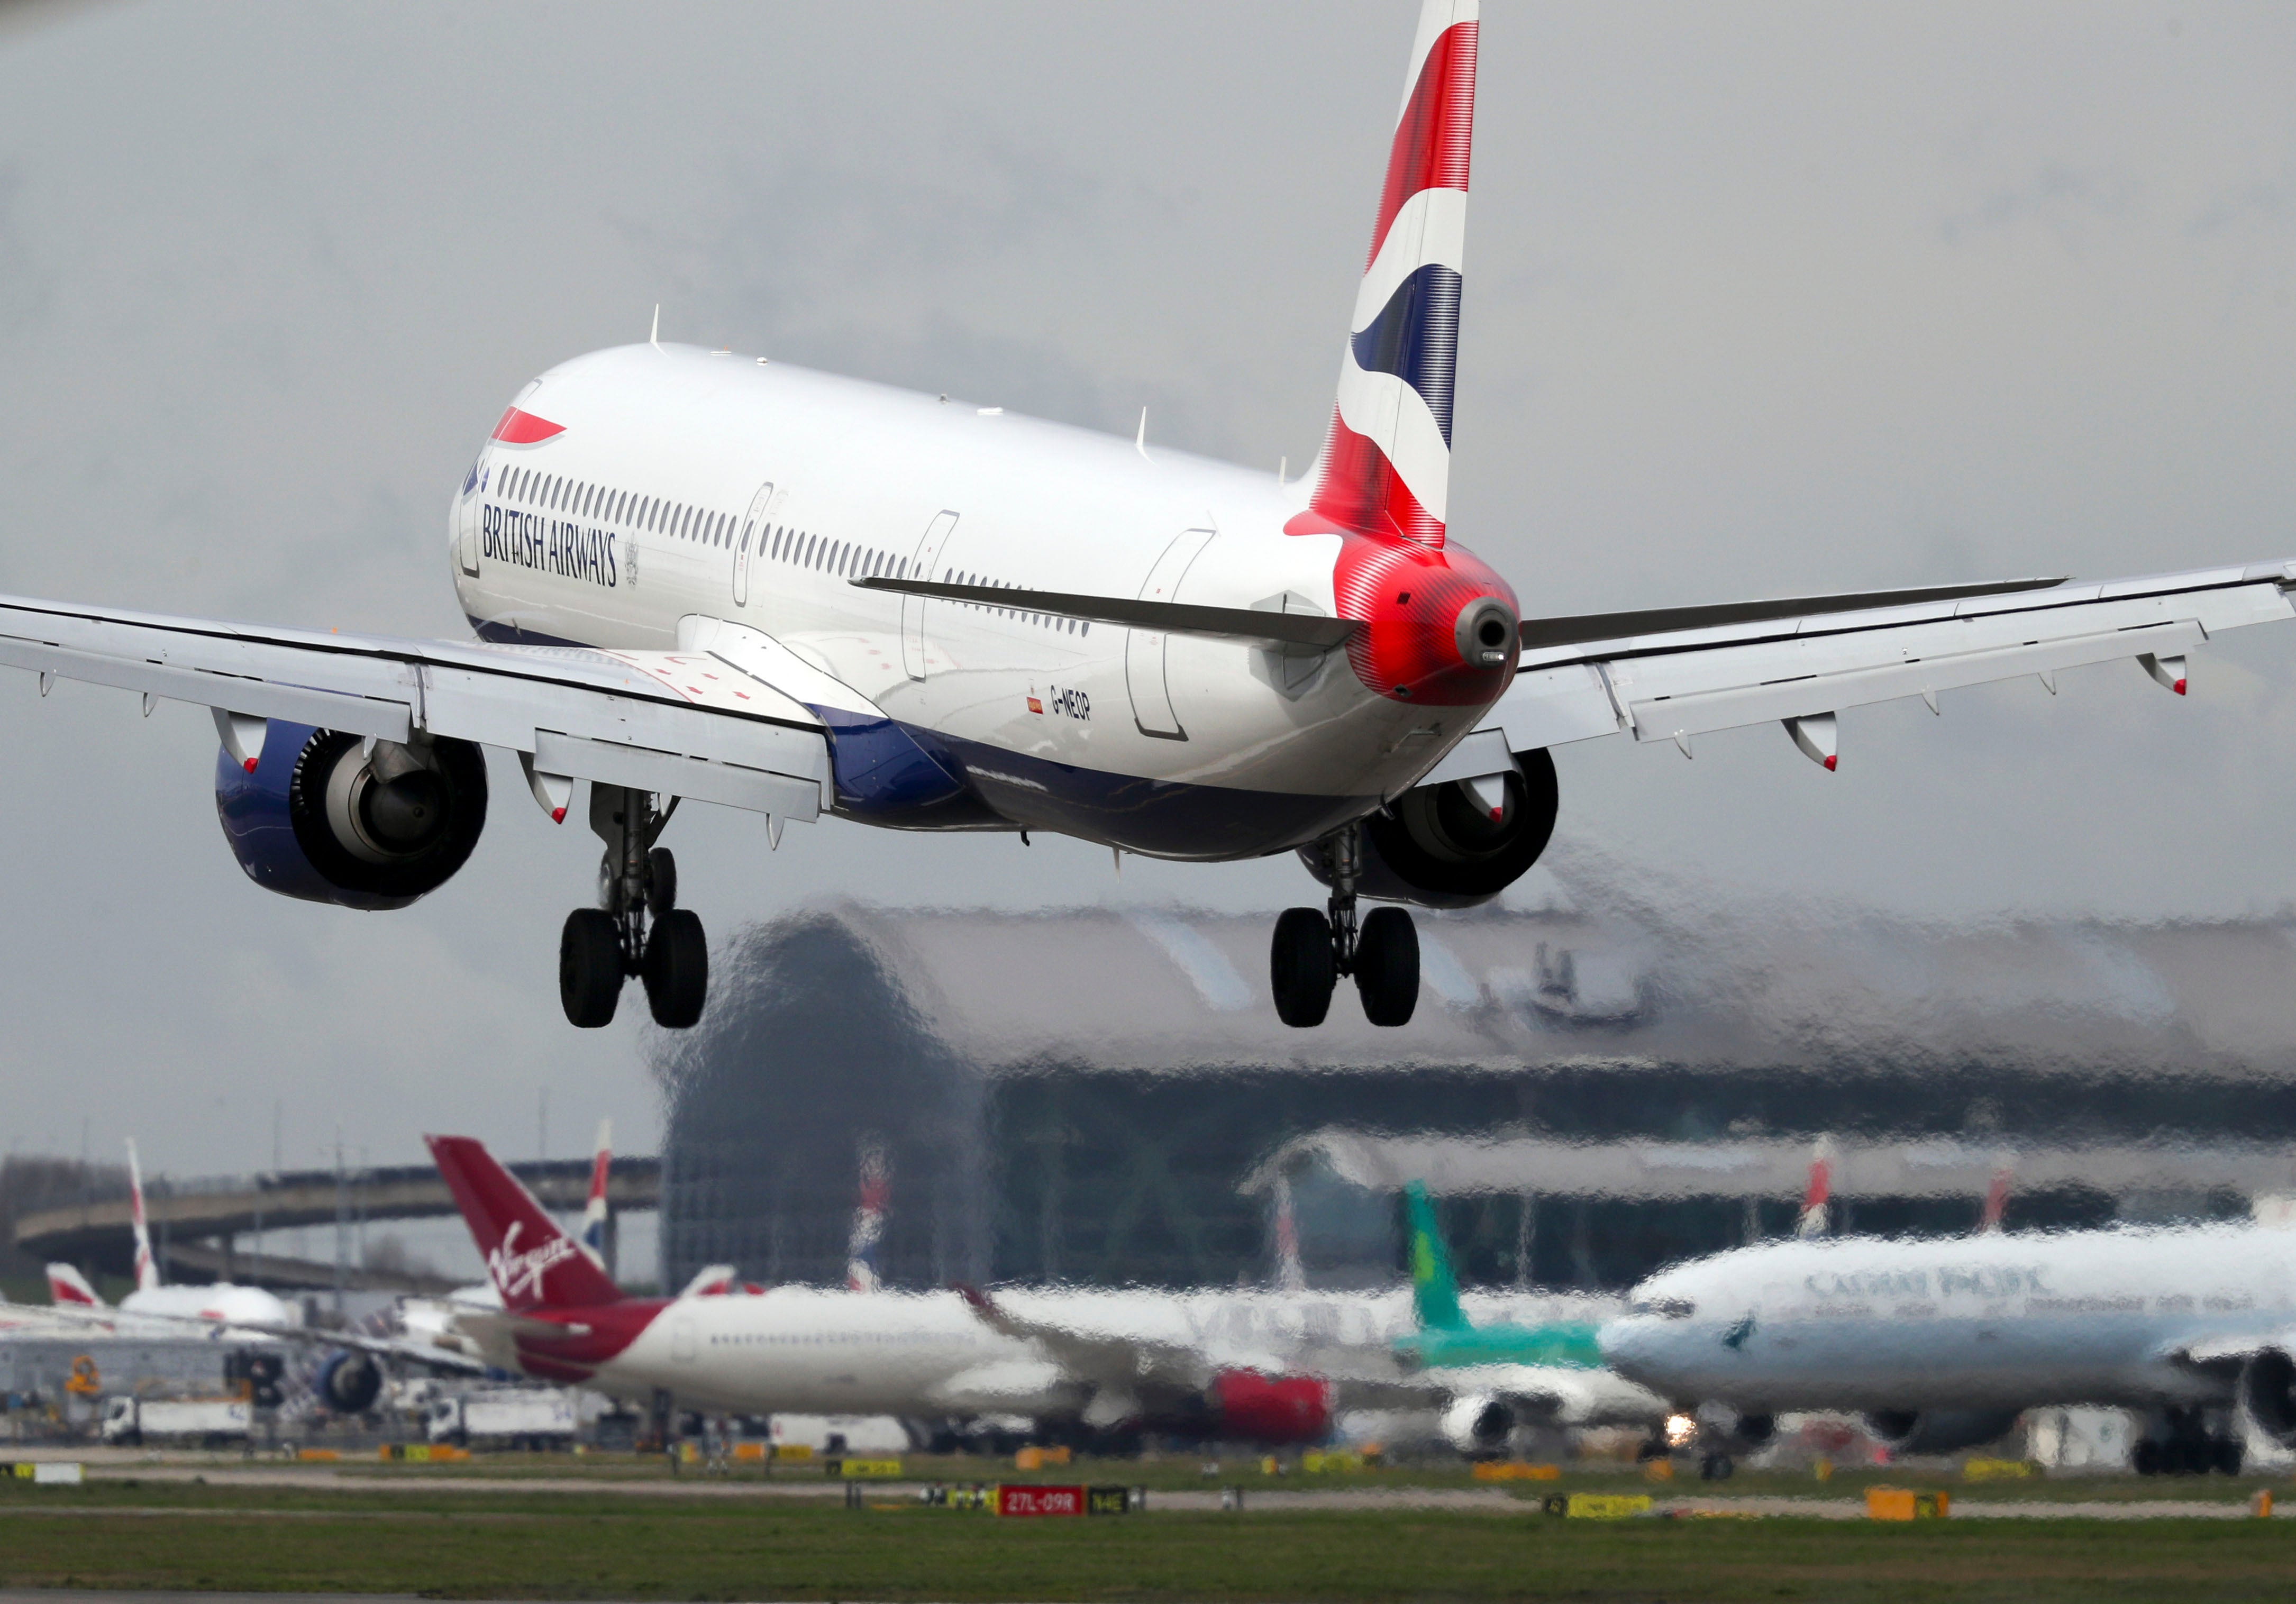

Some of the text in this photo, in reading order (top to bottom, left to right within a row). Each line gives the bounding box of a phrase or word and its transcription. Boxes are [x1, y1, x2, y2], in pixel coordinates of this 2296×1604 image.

[483, 504, 616, 588] BRITISH AIRWAYS
[1050, 685, 1090, 721] G-NEOP
[489, 1220, 576, 1301] Virgin
[1007, 1491, 1075, 1511] 27L-09R
